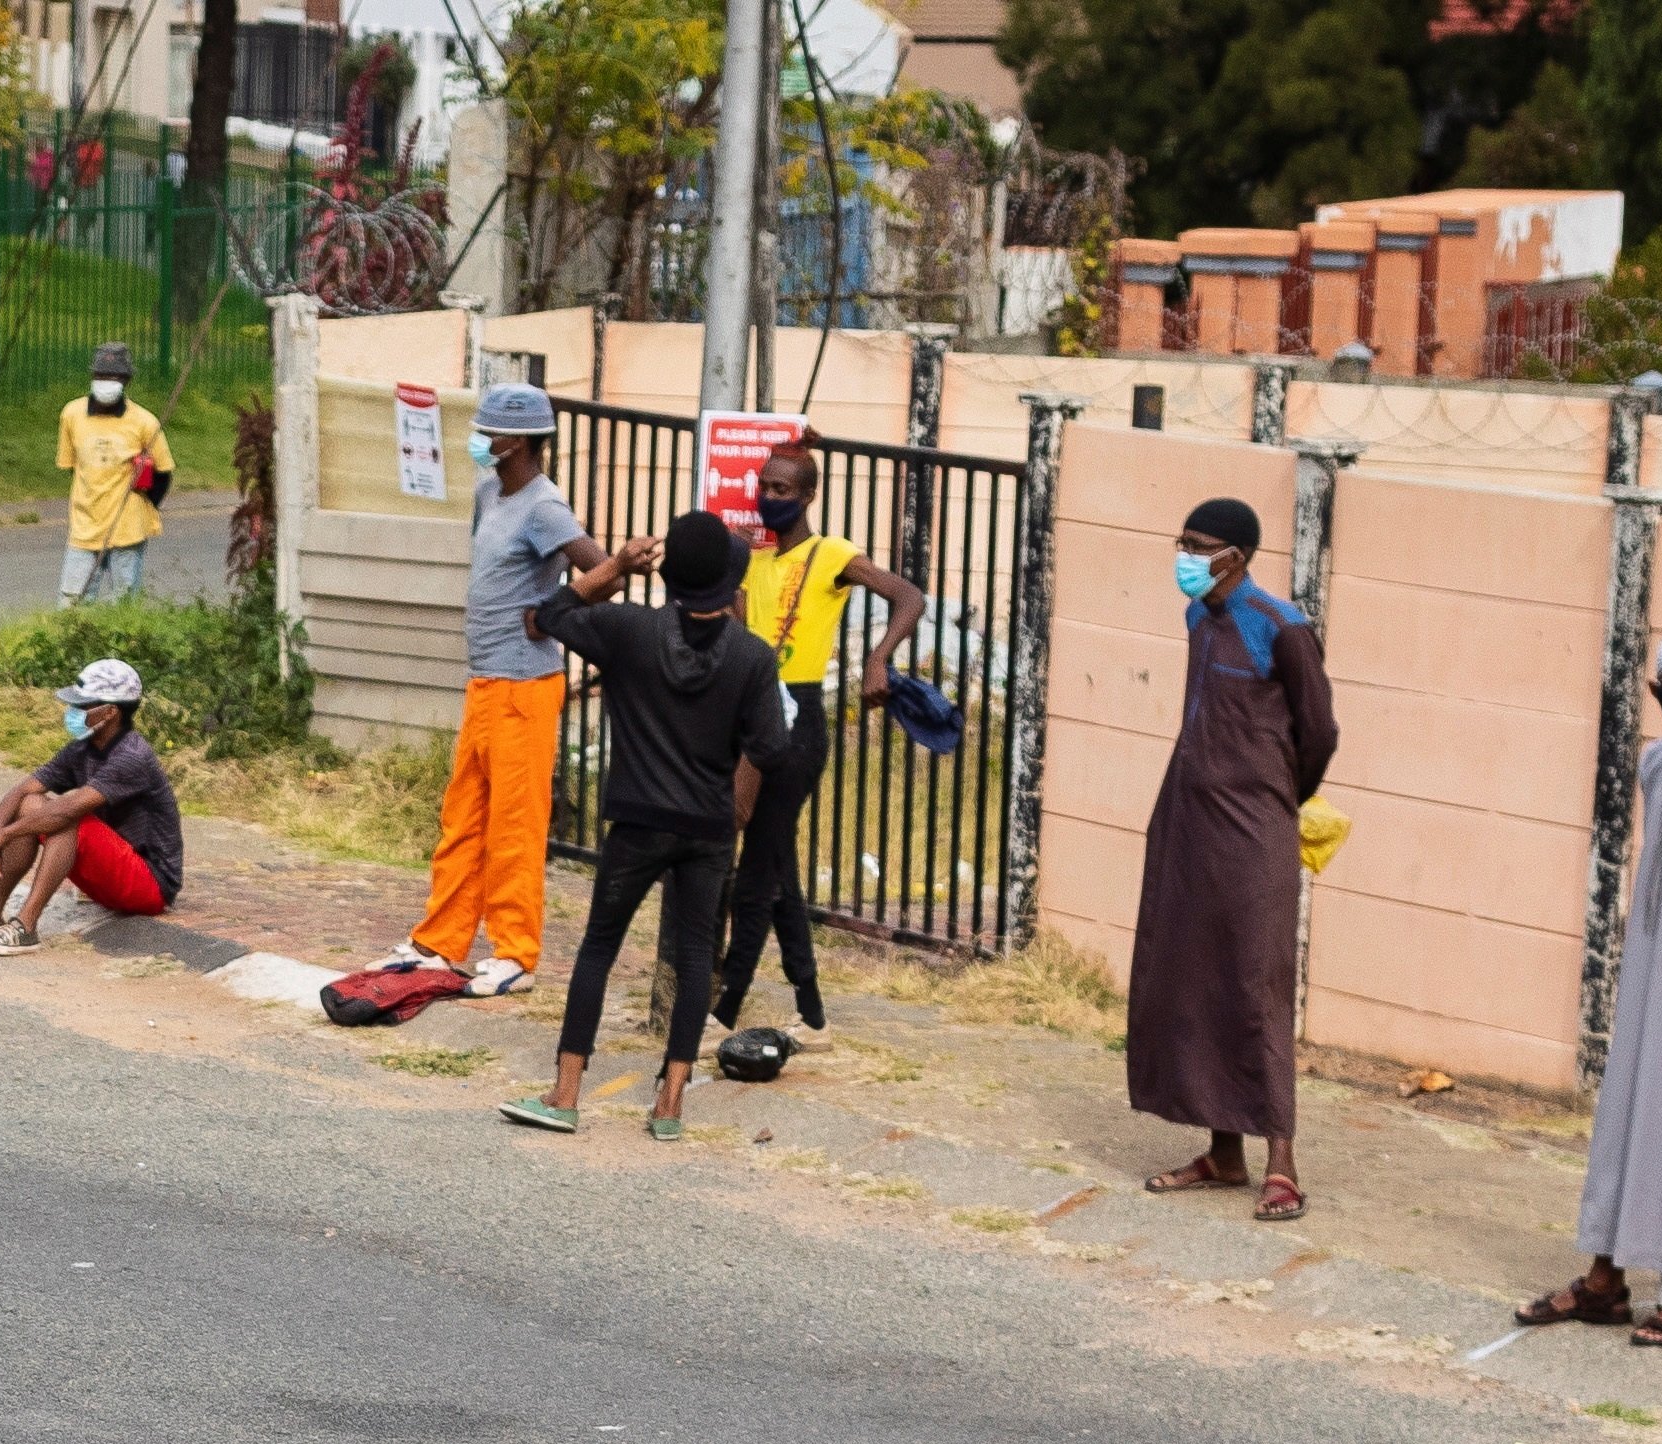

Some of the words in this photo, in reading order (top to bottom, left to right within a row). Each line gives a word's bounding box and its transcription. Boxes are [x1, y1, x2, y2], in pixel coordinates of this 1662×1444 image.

[716, 427, 758, 442] PLEASE
[709, 445, 741, 457] YOUR
[742, 446, 772, 459] DIST
